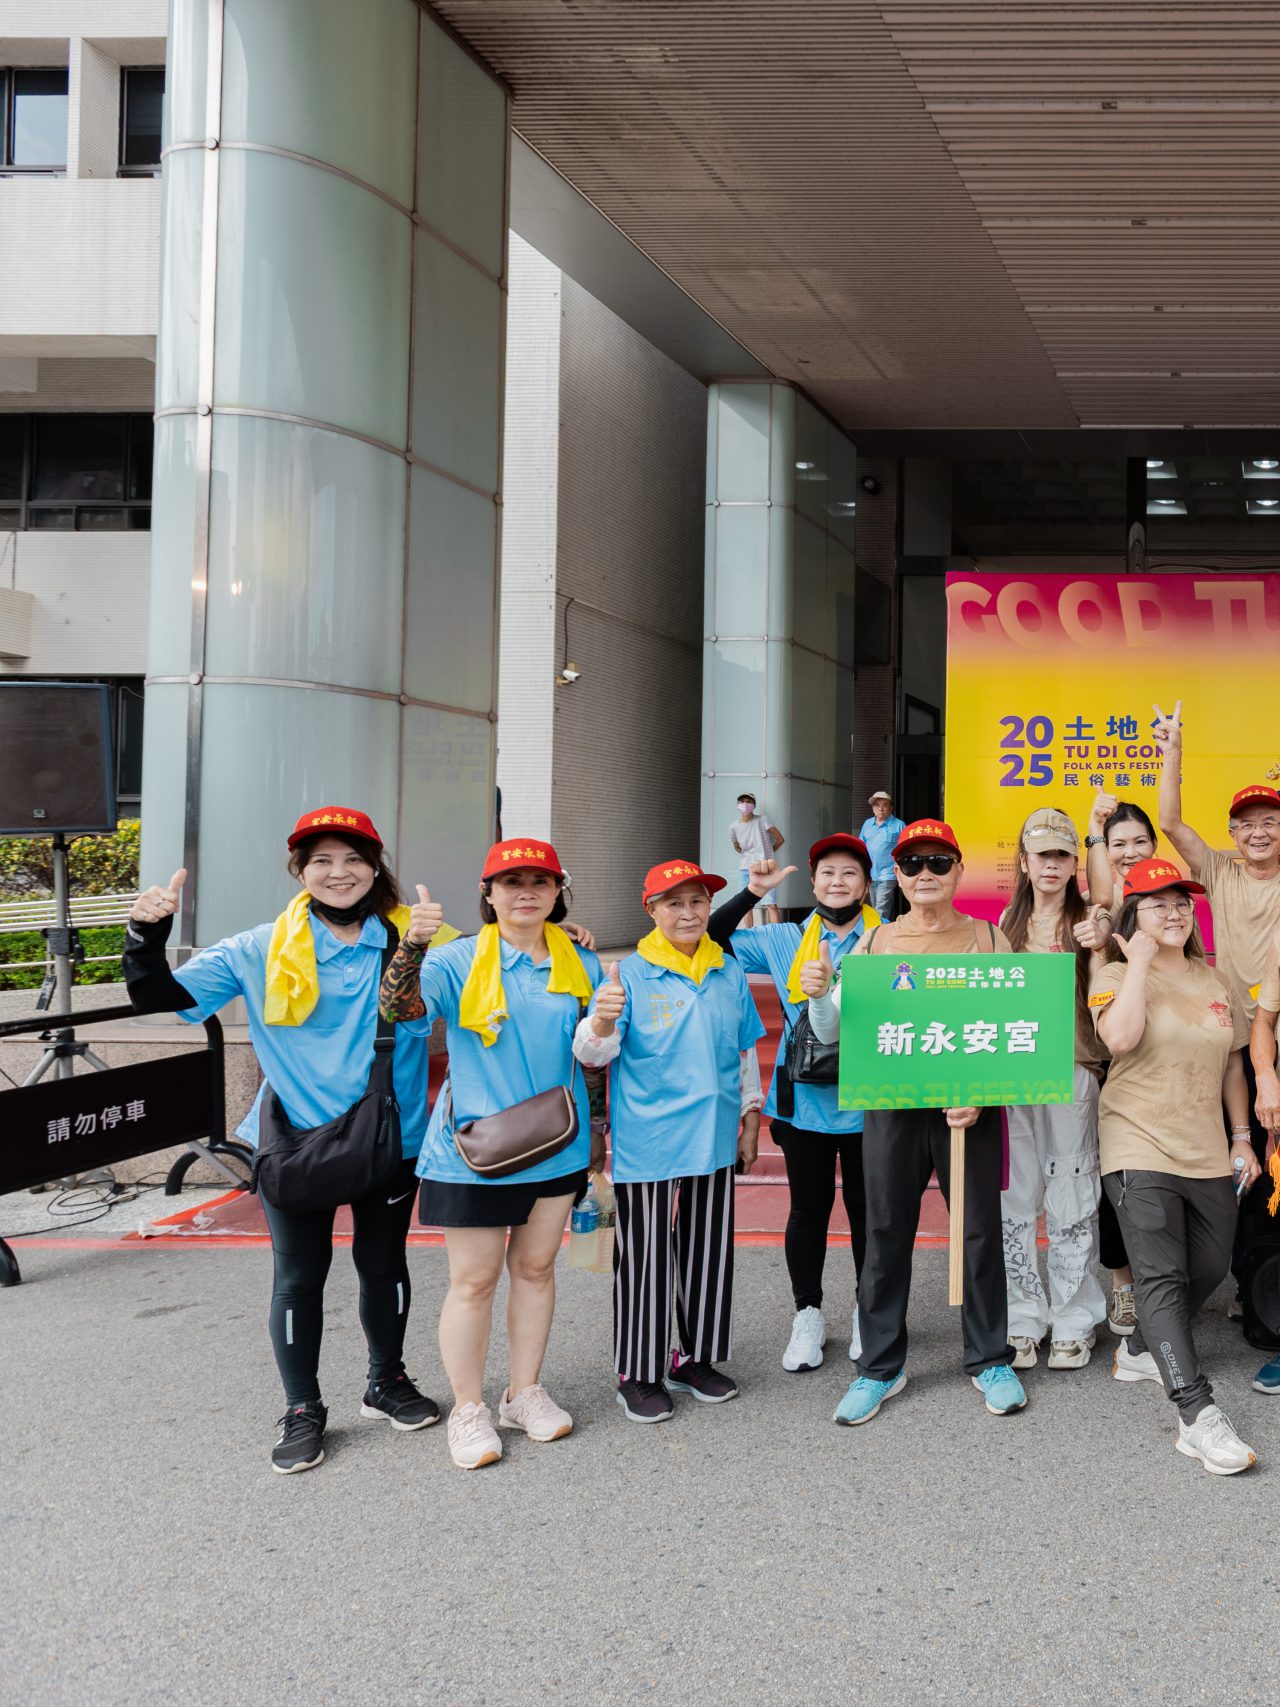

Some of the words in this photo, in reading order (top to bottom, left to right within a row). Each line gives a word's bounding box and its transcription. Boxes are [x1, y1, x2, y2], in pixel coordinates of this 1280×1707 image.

[946, 580, 1168, 648] GOOD
[999, 715, 1054, 748] 20
[1064, 745, 1090, 758] TU
[1098, 745, 1117, 758] DI
[1064, 762, 1092, 770] FOLK
[1096, 762, 1126, 770] ARTS
[999, 754, 1054, 786] 25
[1063, 773, 1182, 786] 民俗藝術
[925, 967, 967, 979] 2025
[968, 966, 1025, 980] 土地公
[877, 1019, 1040, 1056] 新永安宮
[47, 1099, 147, 1144] 請勿停車
